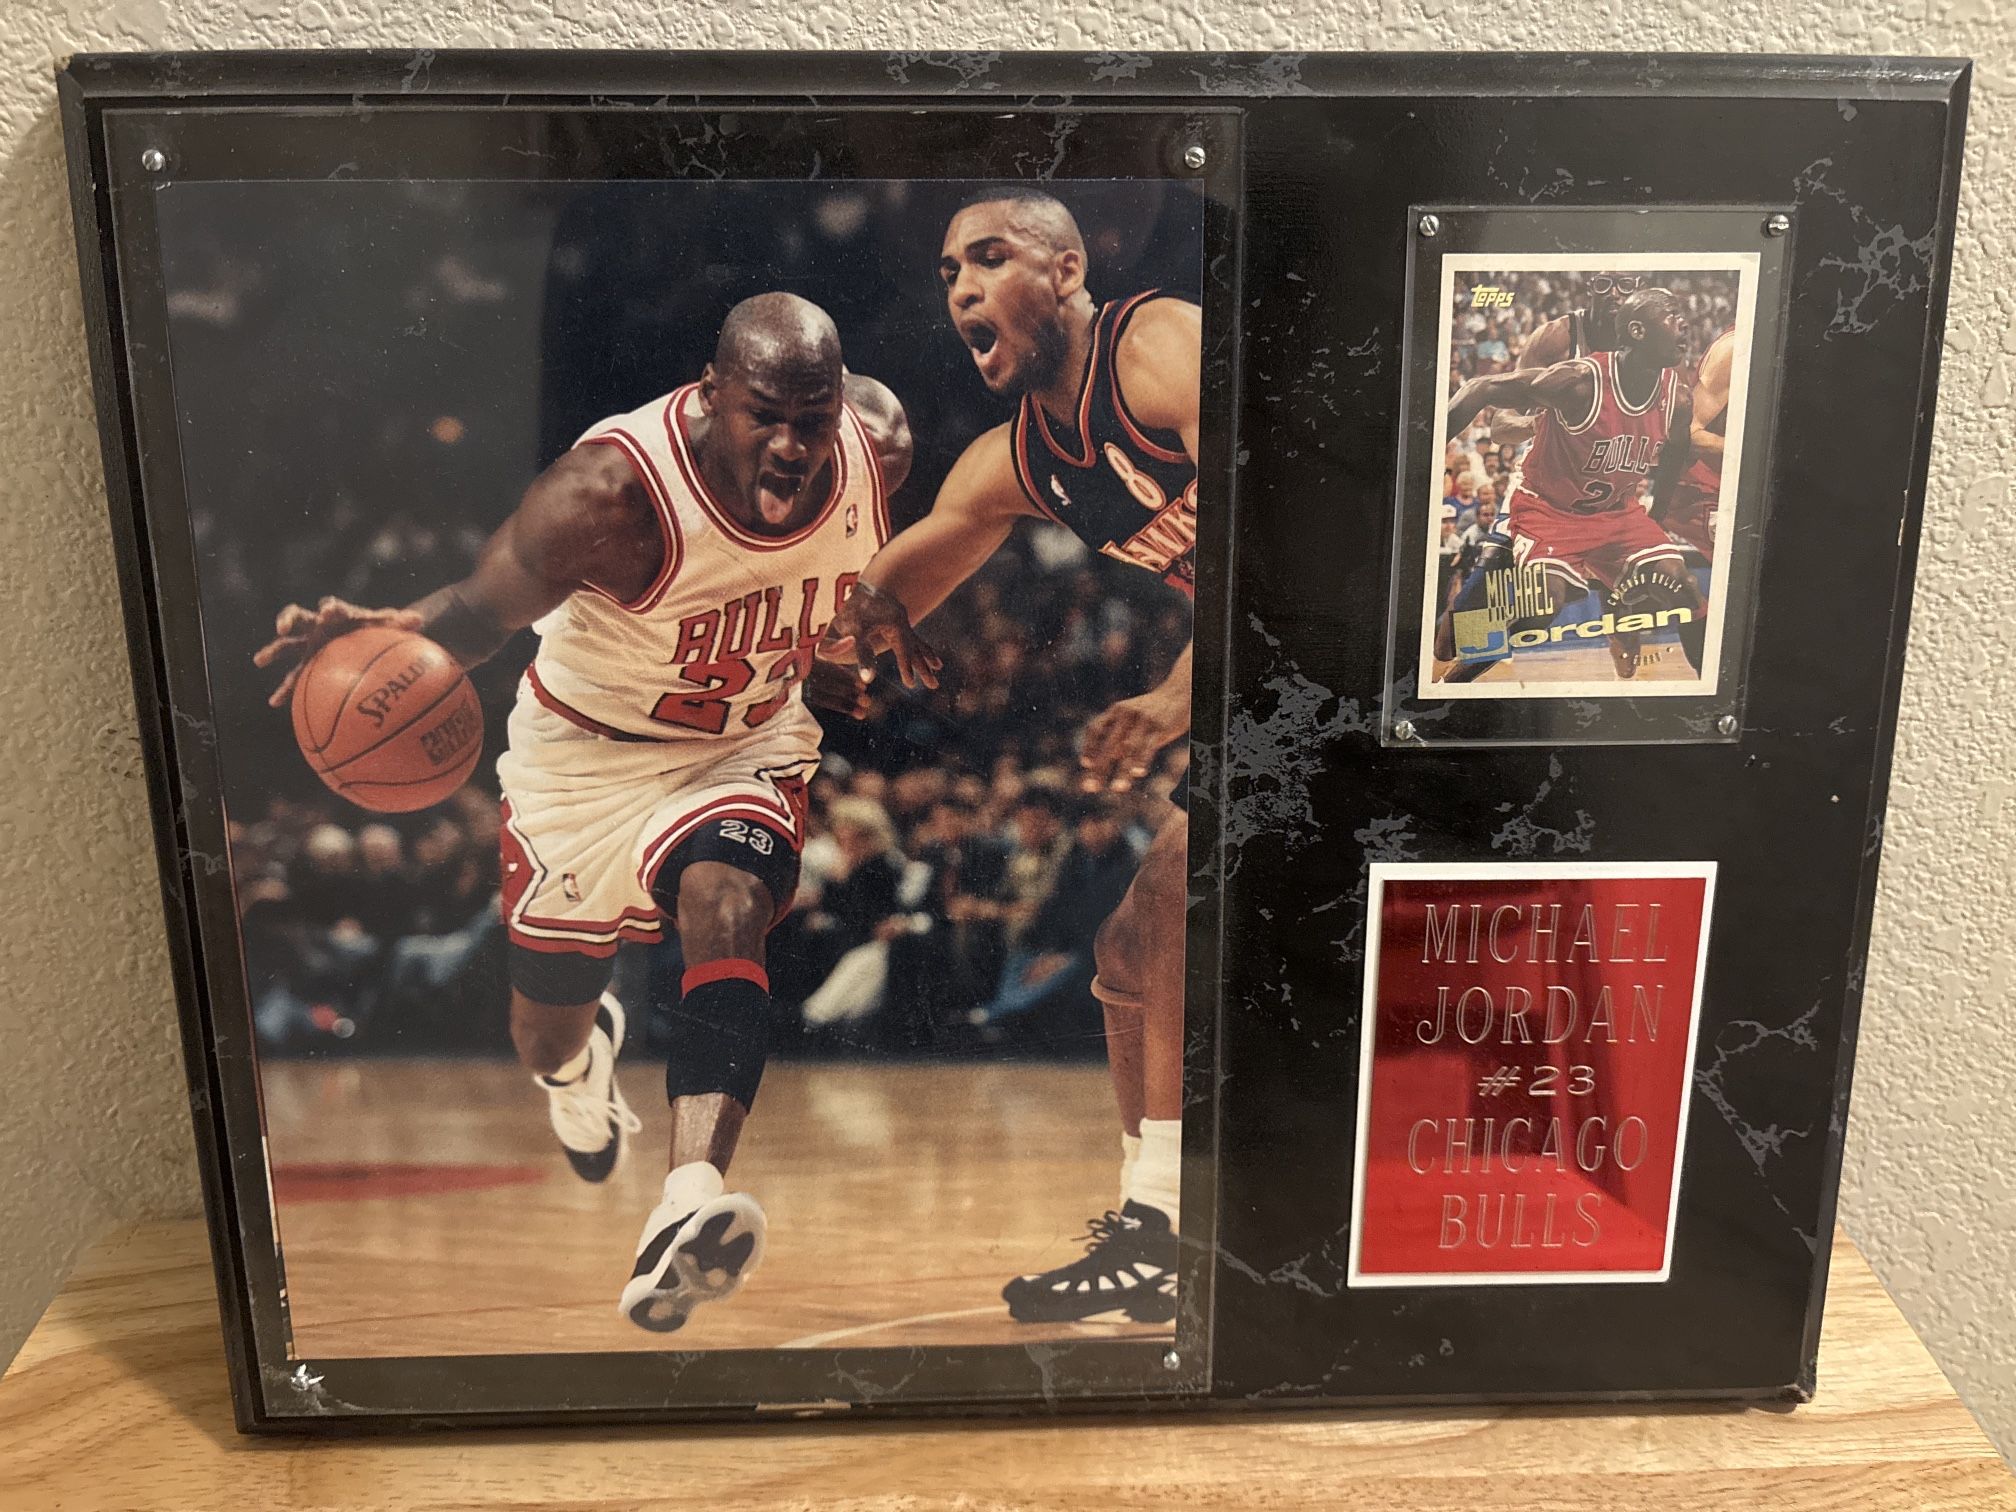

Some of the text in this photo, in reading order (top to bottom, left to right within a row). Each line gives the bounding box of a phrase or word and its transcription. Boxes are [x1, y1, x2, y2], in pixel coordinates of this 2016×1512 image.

[1104, 441, 1167, 511] 8
[1485, 562, 1554, 622] MICHAEL
[1459, 606, 1692, 656] Jordan
[649, 648, 814, 735] 23
[720, 820, 774, 855] 23
[1421, 903, 1669, 963] MICHAEL
[1416, 984, 1664, 1044] JORDAN
[1408, 1115, 1648, 1174] CHICAGO
[1438, 1193, 1602, 1249] BULLS
